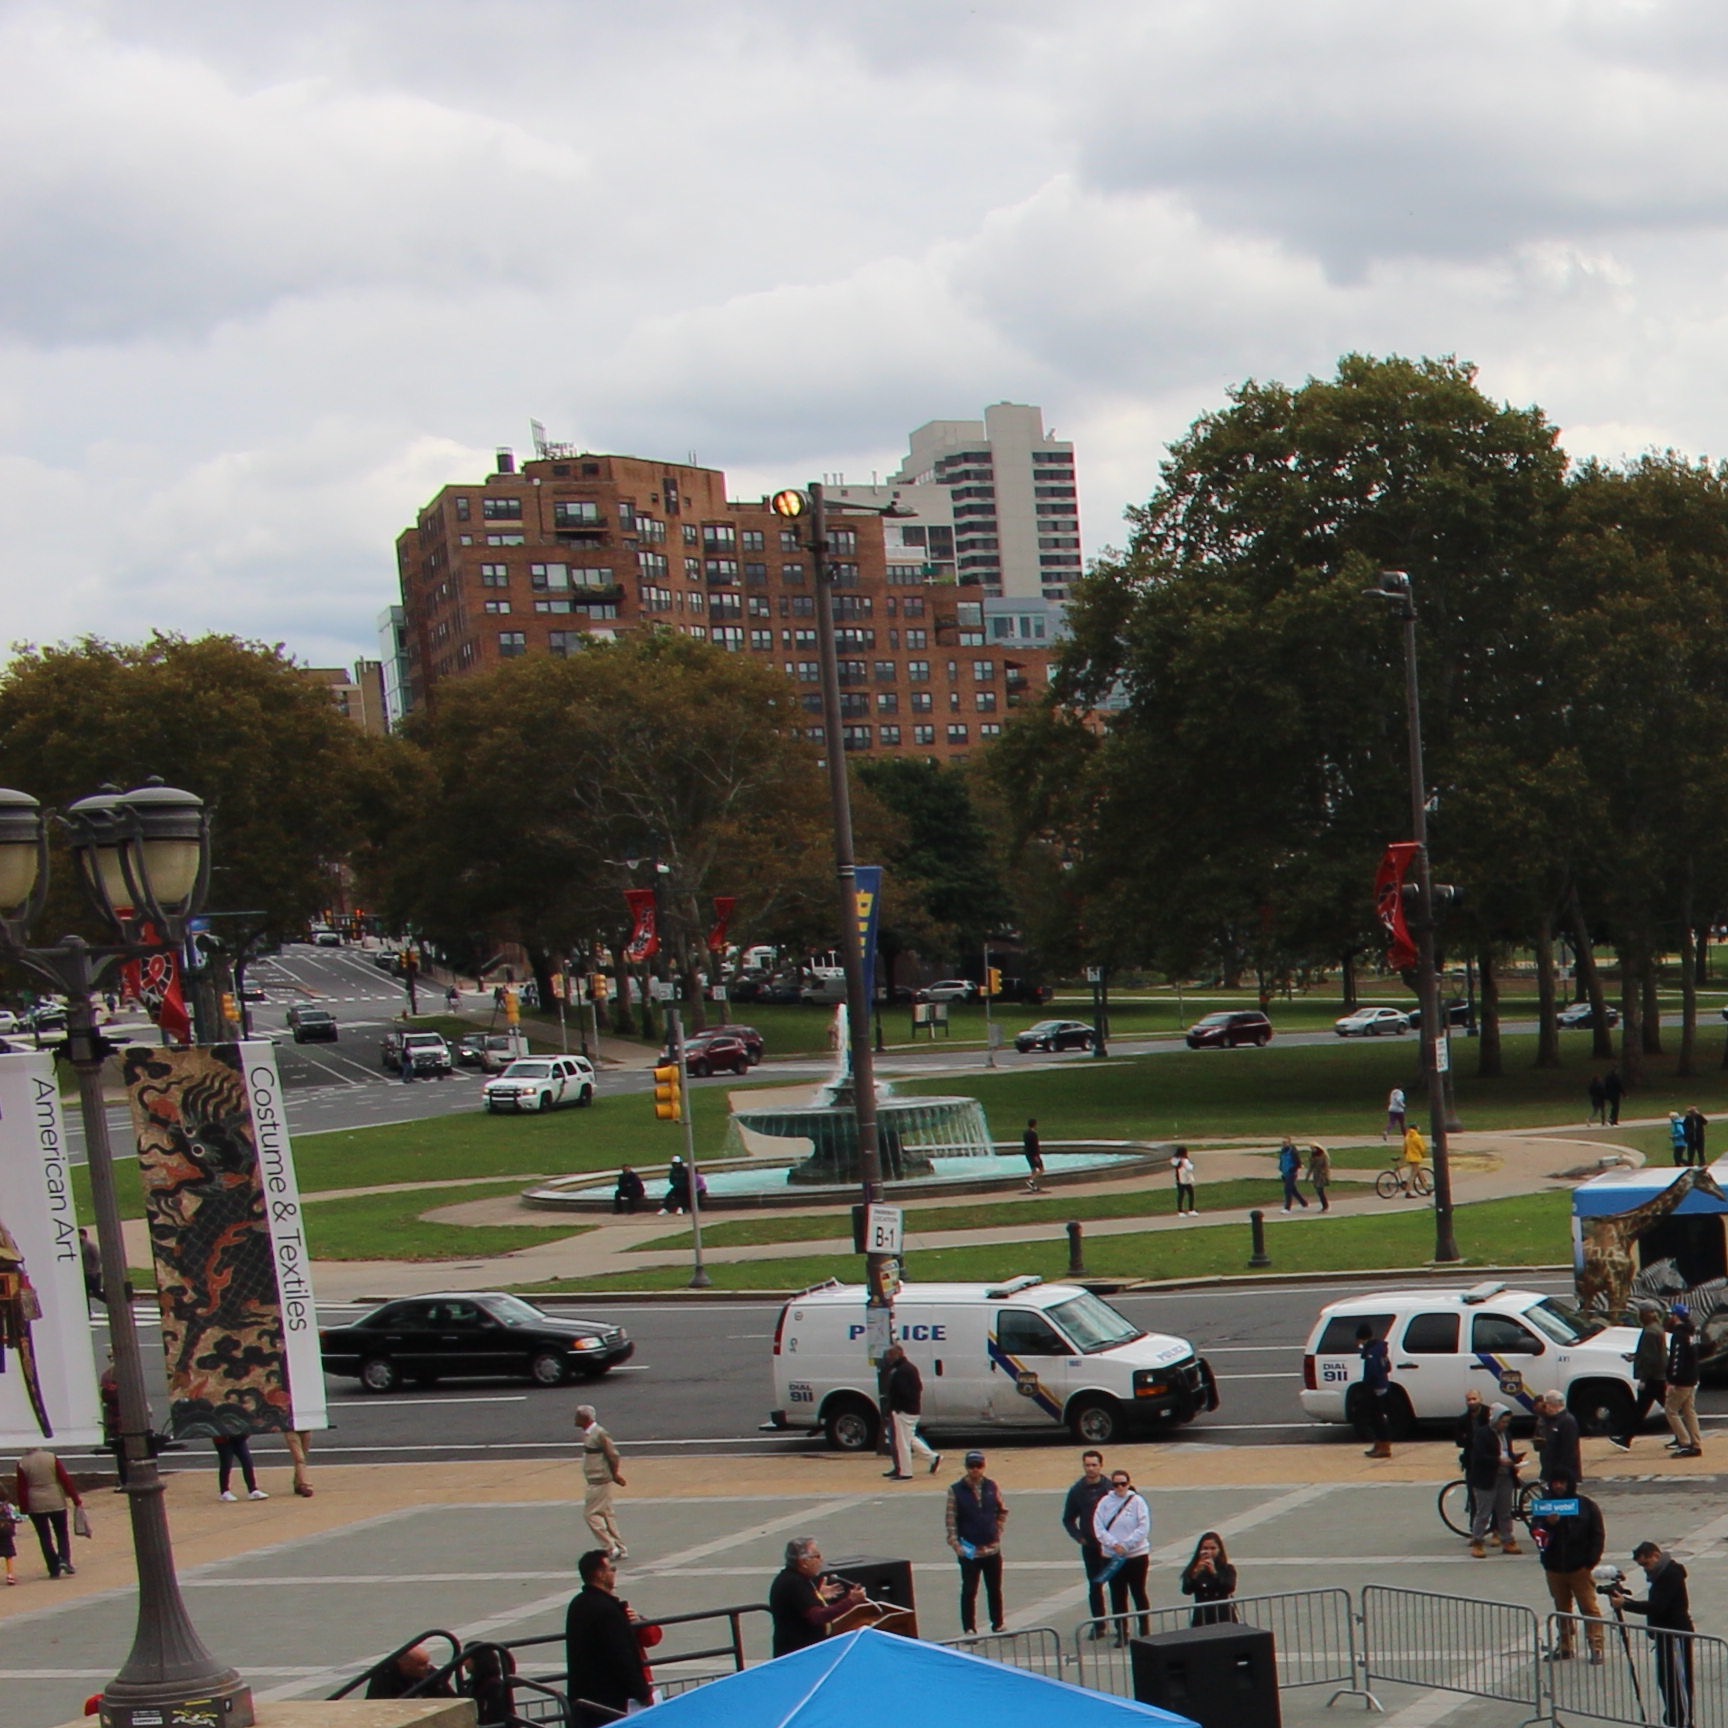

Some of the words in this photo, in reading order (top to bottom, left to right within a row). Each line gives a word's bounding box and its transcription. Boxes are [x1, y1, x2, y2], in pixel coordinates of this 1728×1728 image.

[250, 1066, 287, 1193] Costume
[32, 1077, 67, 1211] American
[52, 1217, 77, 1262] Art
[272, 1200, 297, 1223] &
[876, 1226, 895, 1249] B-1
[277, 1227, 310, 1332] Textiles
[849, 1324, 947, 1341] PICE
[1323, 1370, 1348, 1382] 911
[789, 1391, 814, 1403] 911
